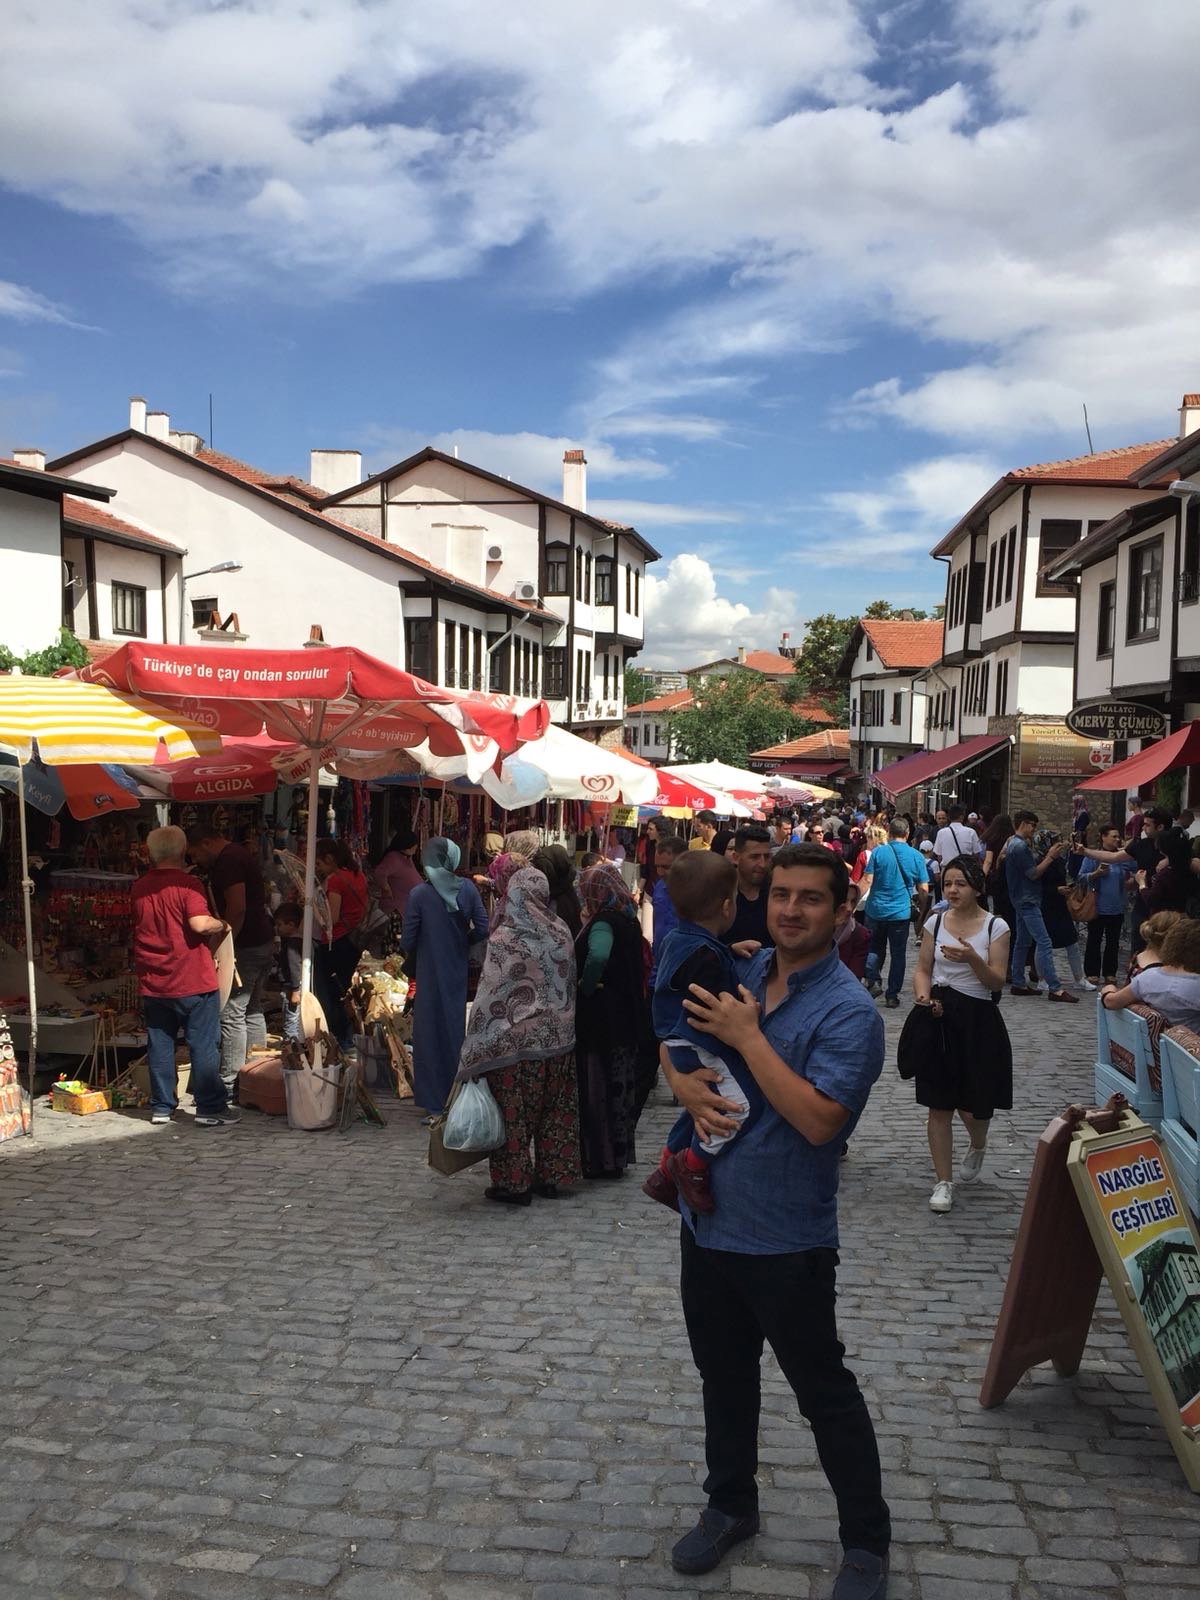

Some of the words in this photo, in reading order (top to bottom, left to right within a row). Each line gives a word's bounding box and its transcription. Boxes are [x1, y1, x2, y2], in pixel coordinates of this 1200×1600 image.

[143, 657, 213, 678] Türkiye'de
[217, 668, 240, 682] çay
[244, 670, 282, 681] ondan
[286, 667, 329, 681] sorulur
[1074, 715, 1115, 728] MERVE
[1119, 713, 1161, 732] GÜMÜŞ
[1108, 728, 1128, 739] EVİ
[1090, 751, 1112, 764] ÖZ
[1098, 1155, 1164, 1195] NARGİLE
[1112, 1190, 1178, 1238] ÇEŞİTLERİ
